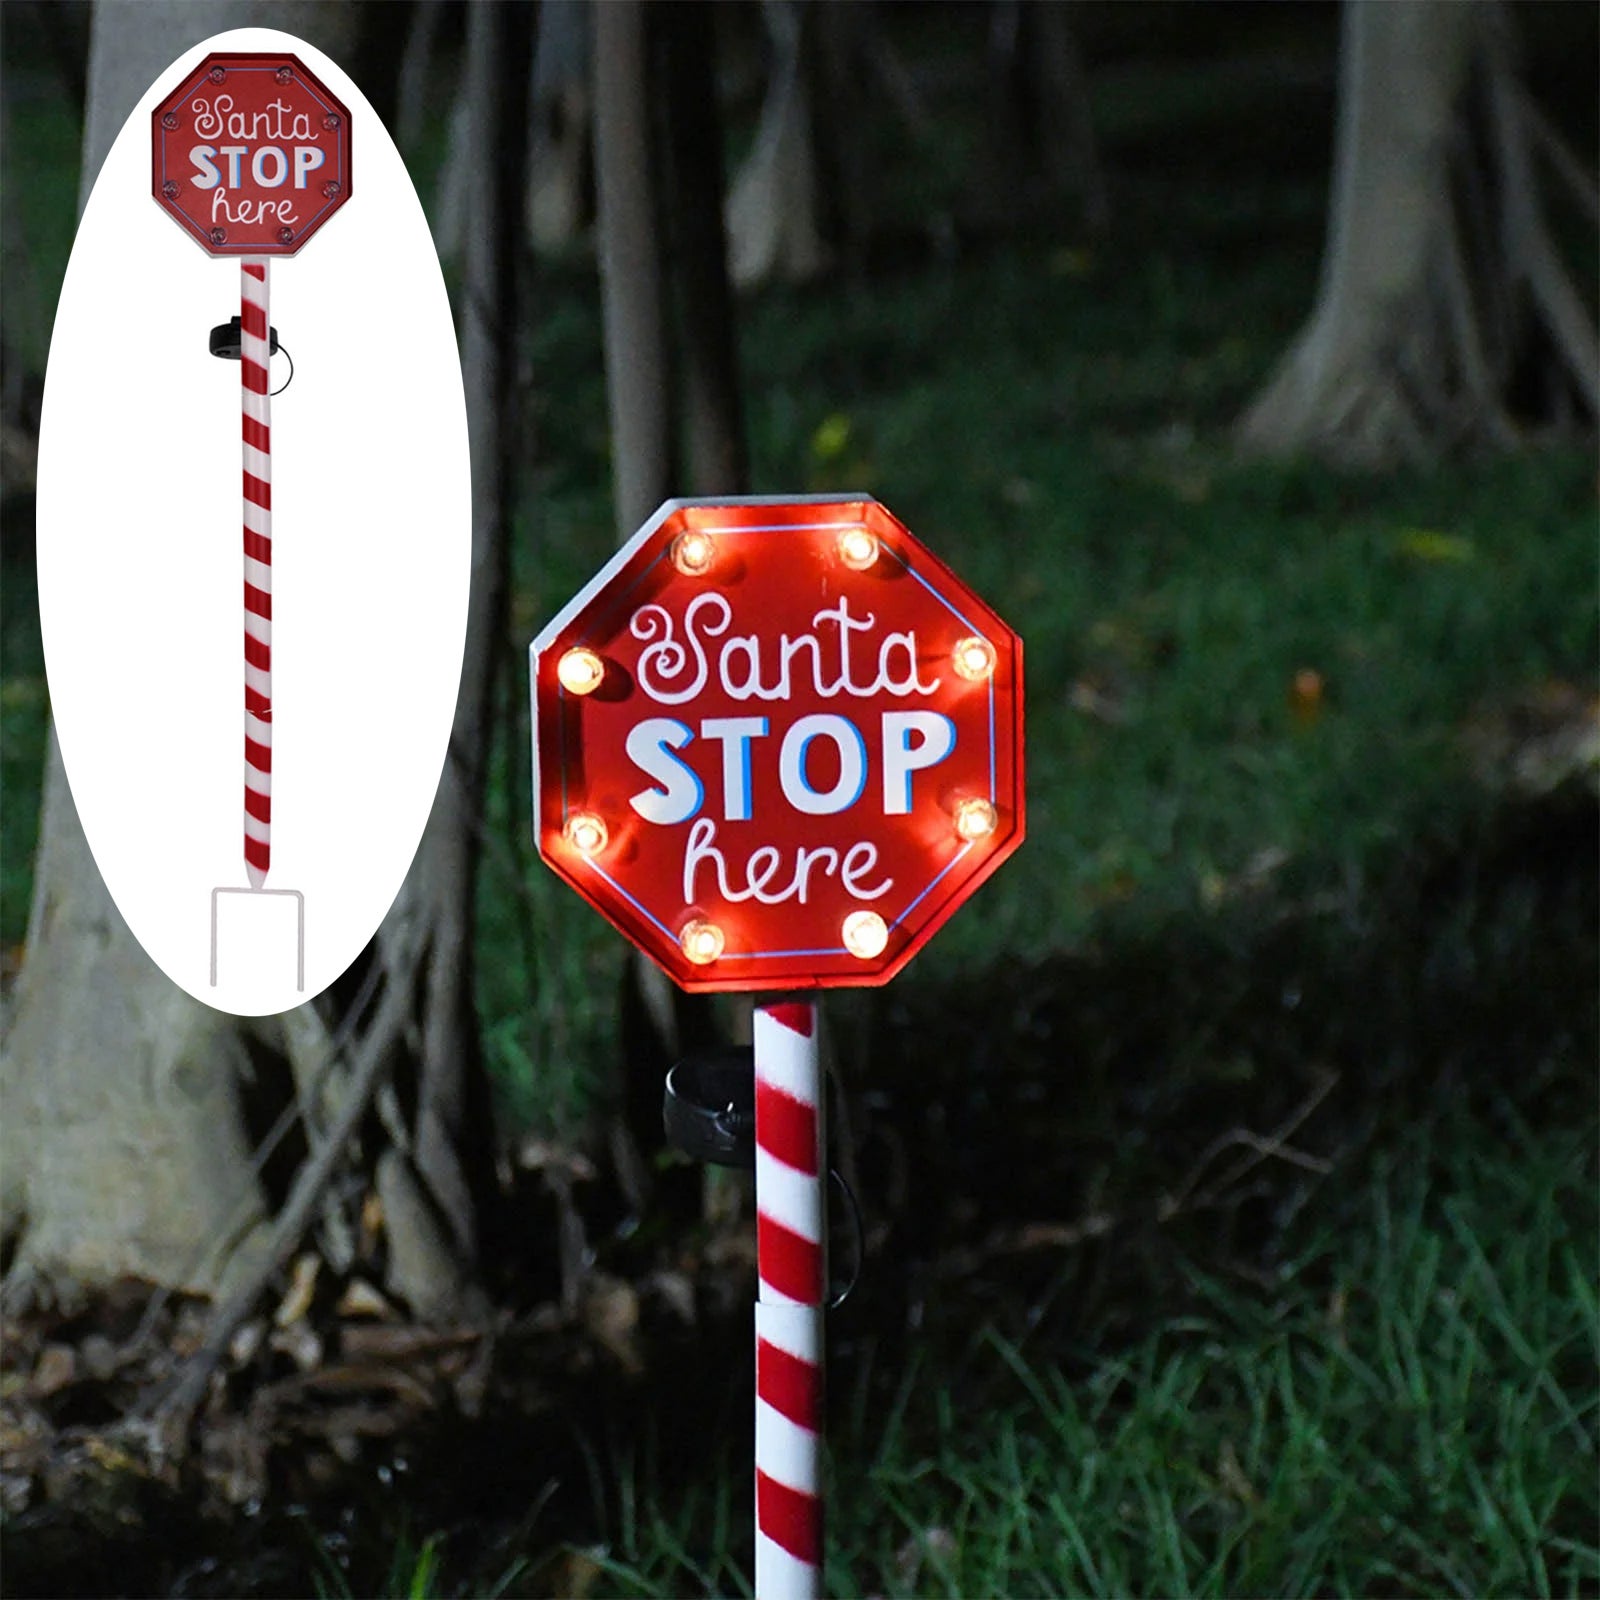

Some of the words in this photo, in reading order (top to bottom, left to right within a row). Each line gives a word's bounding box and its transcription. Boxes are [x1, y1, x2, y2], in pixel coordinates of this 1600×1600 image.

[191, 94, 319, 140] Santa
[188, 144, 326, 190] STOP
[211, 186, 299, 225] here
[629, 591, 941, 705] Santa
[625, 709, 957, 825] STOP
[683, 817, 893, 905] here
